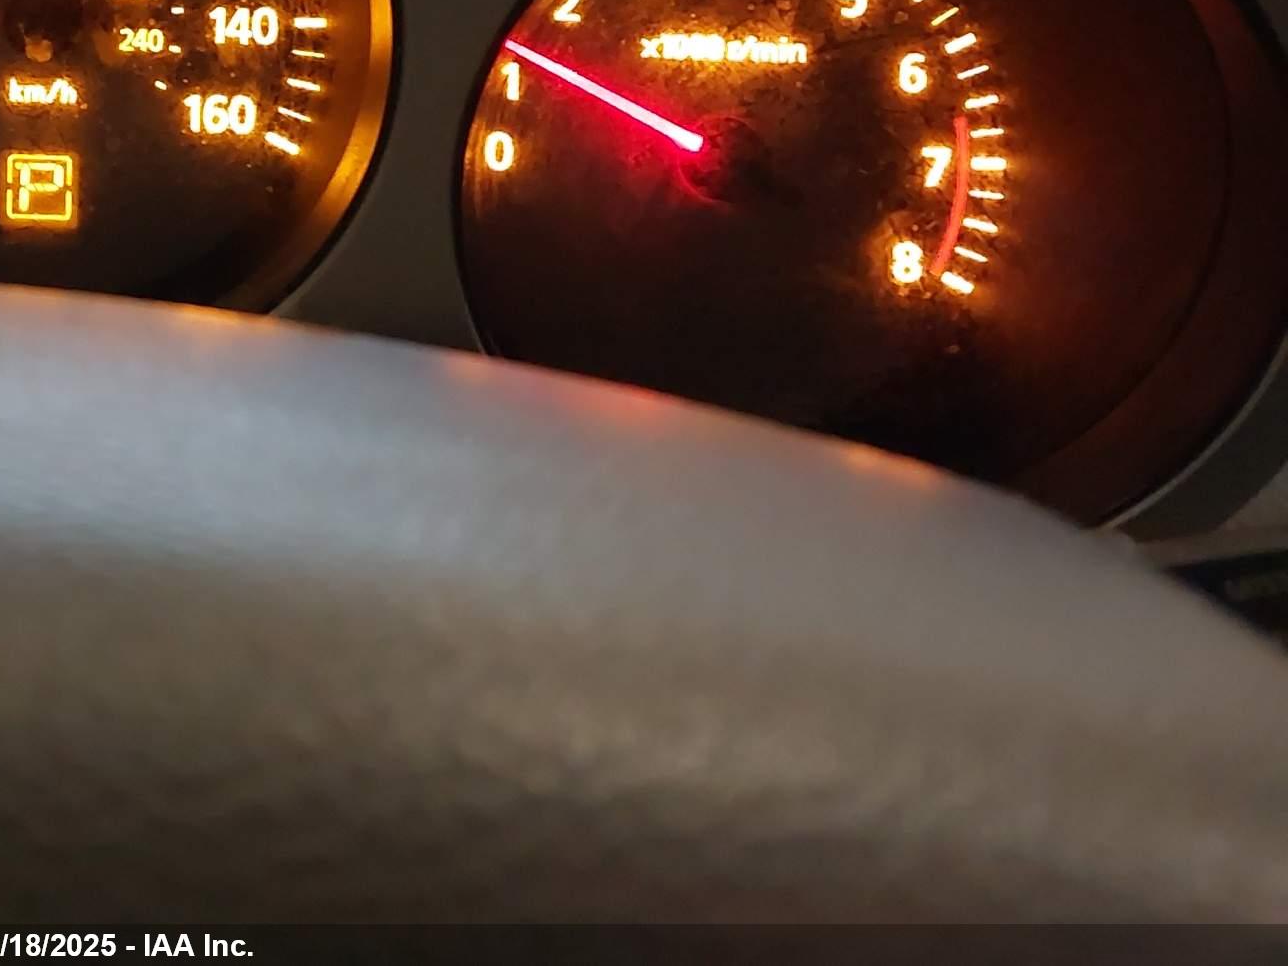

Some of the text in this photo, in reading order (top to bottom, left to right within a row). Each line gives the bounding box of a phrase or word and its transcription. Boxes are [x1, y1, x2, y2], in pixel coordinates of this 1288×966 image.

[118, 28, 165, 53] 240
[208, 6, 279, 47] 140
[8, 77, 79, 105] km/h
[500, 61, 520, 101] 1
[898, 52, 928, 95] 6
[183, 94, 258, 135] 160
[484, 130, 515, 172] 0
[920, 144, 953, 188] 7
[15, 161, 64, 212] P
[890, 239, 924, 284] 8
